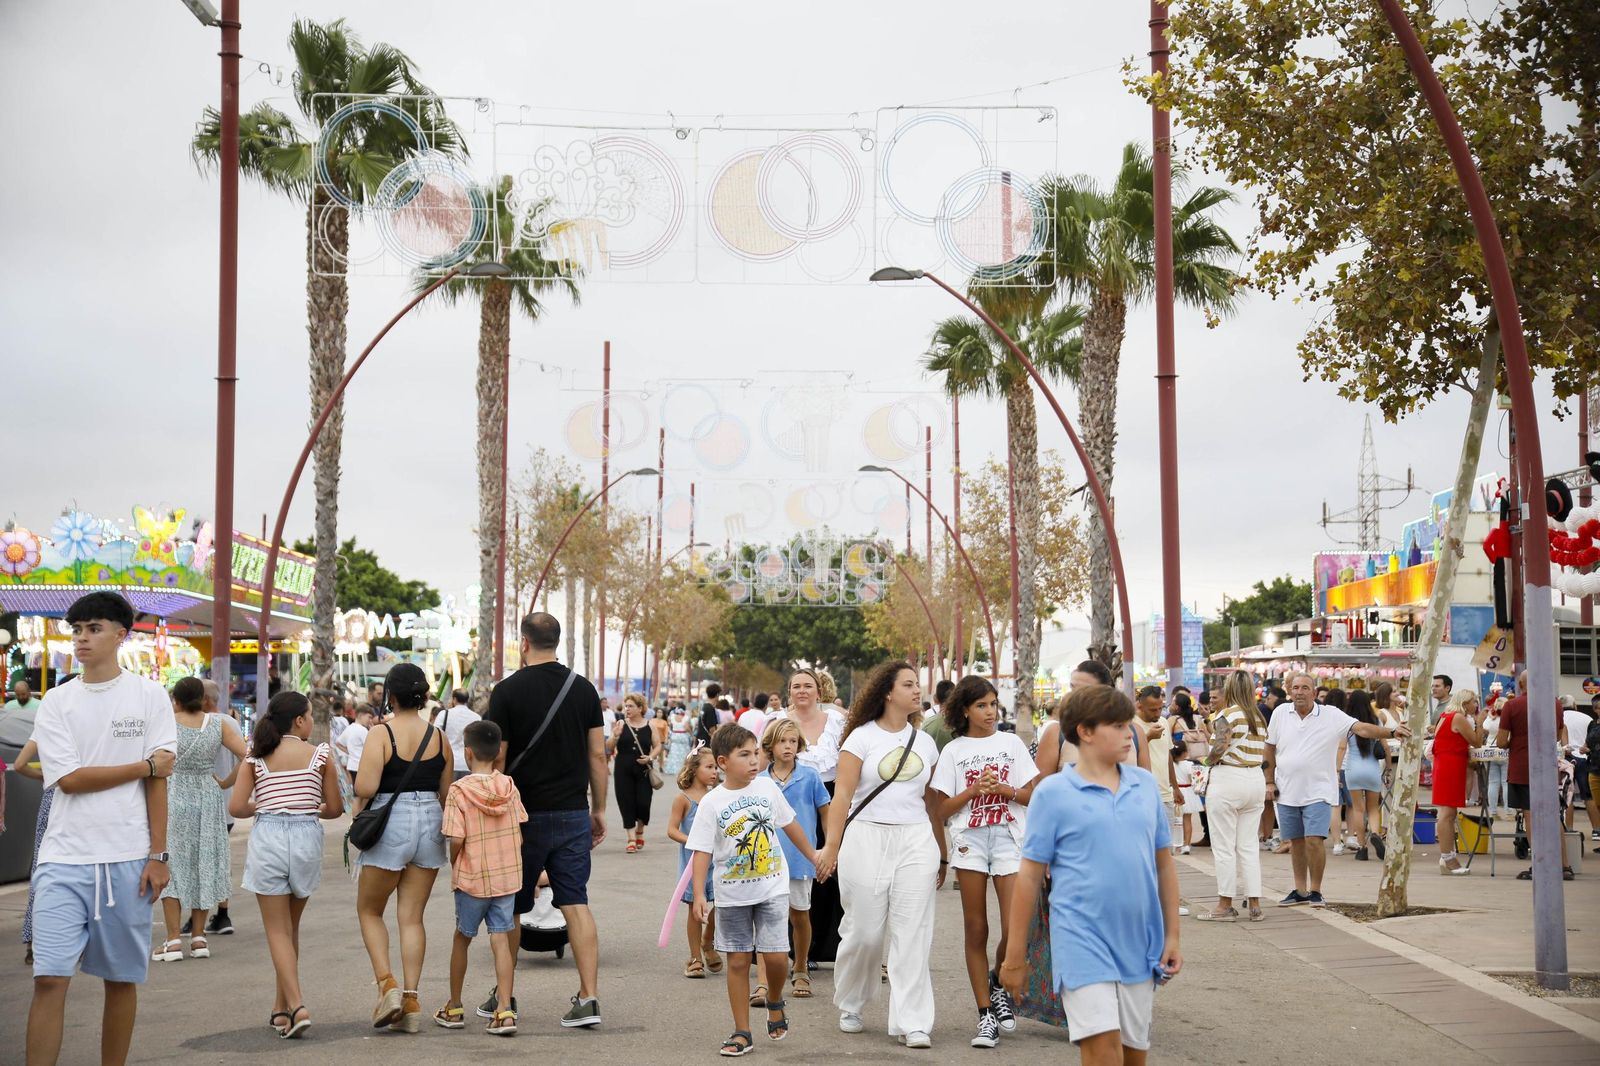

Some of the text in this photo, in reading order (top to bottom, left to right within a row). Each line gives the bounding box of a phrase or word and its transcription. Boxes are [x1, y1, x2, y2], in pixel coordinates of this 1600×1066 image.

[112, 720, 122, 728] New
[124, 719, 136, 728] York
[113, 728, 144, 738] Central Park
[957, 758, 970, 769] The
[719, 795, 772, 829] POKÉMO
